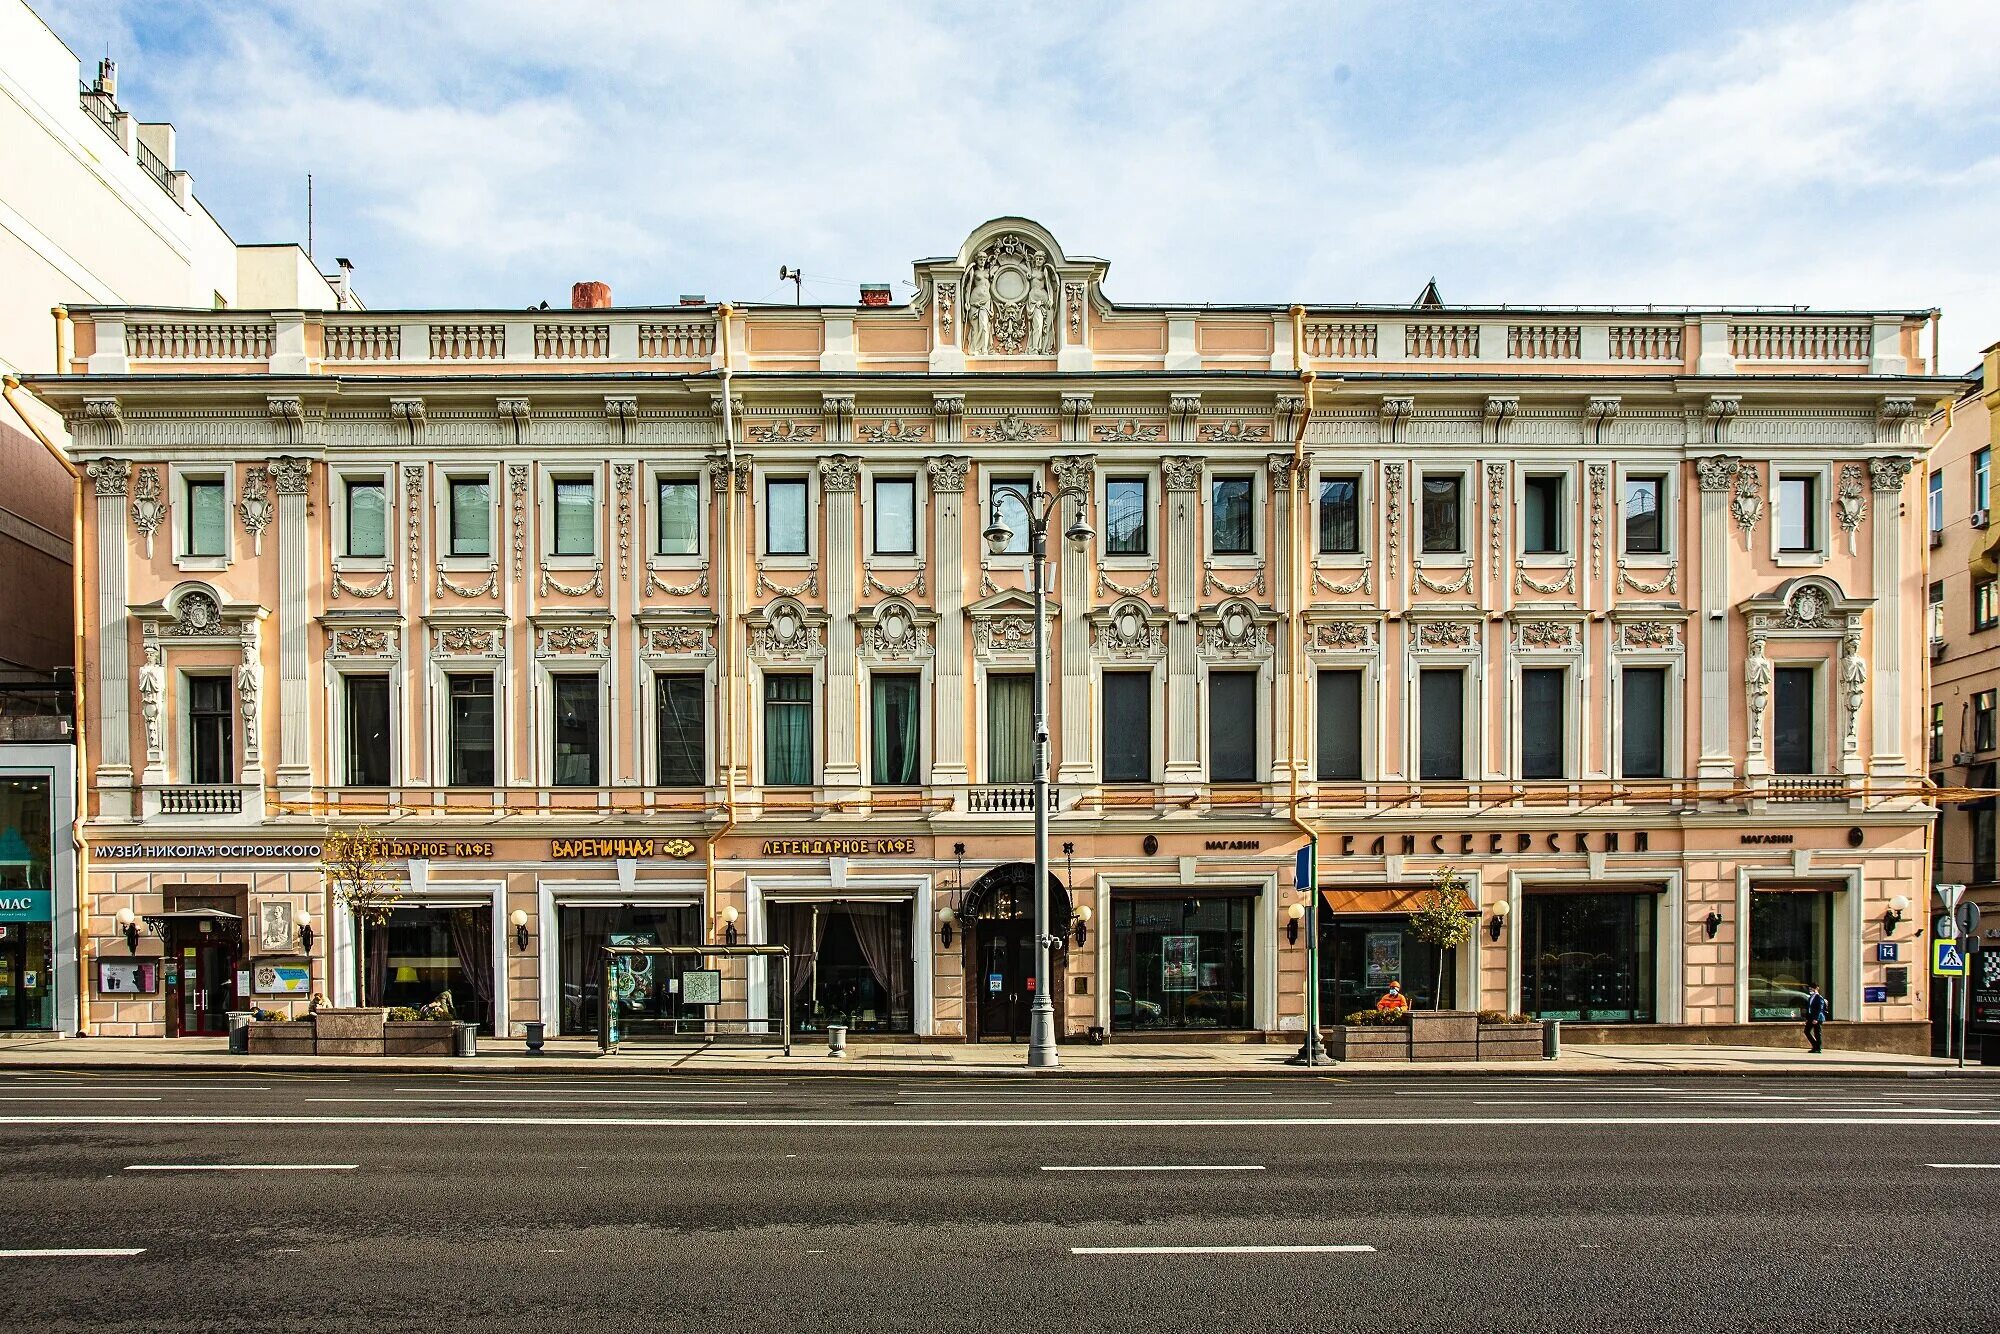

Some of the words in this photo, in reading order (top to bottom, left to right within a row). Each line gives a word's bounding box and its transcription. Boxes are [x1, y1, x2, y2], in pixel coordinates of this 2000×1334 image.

[1205, 840, 1260, 850] МАГАЗИН
[1741, 835, 1794, 844] МАГАЗИН
[95, 843, 142, 857] МУЗЕЙ
[146, 845, 215, 857] НИКОЛАЯ
[219, 845, 321, 857] ОСТРОВСКОГО
[455, 842, 493, 856] КАФЕ
[552, 839, 654, 857] ВАРЕНИЧНАЯ
[763, 840, 868, 854] ЛЕГЕНДАРНОЕ
[877, 839, 915, 853] КАФЕ
[1883, 948, 1894, 957] 14
[1976, 995, 2000, 1003] ШАХМ
